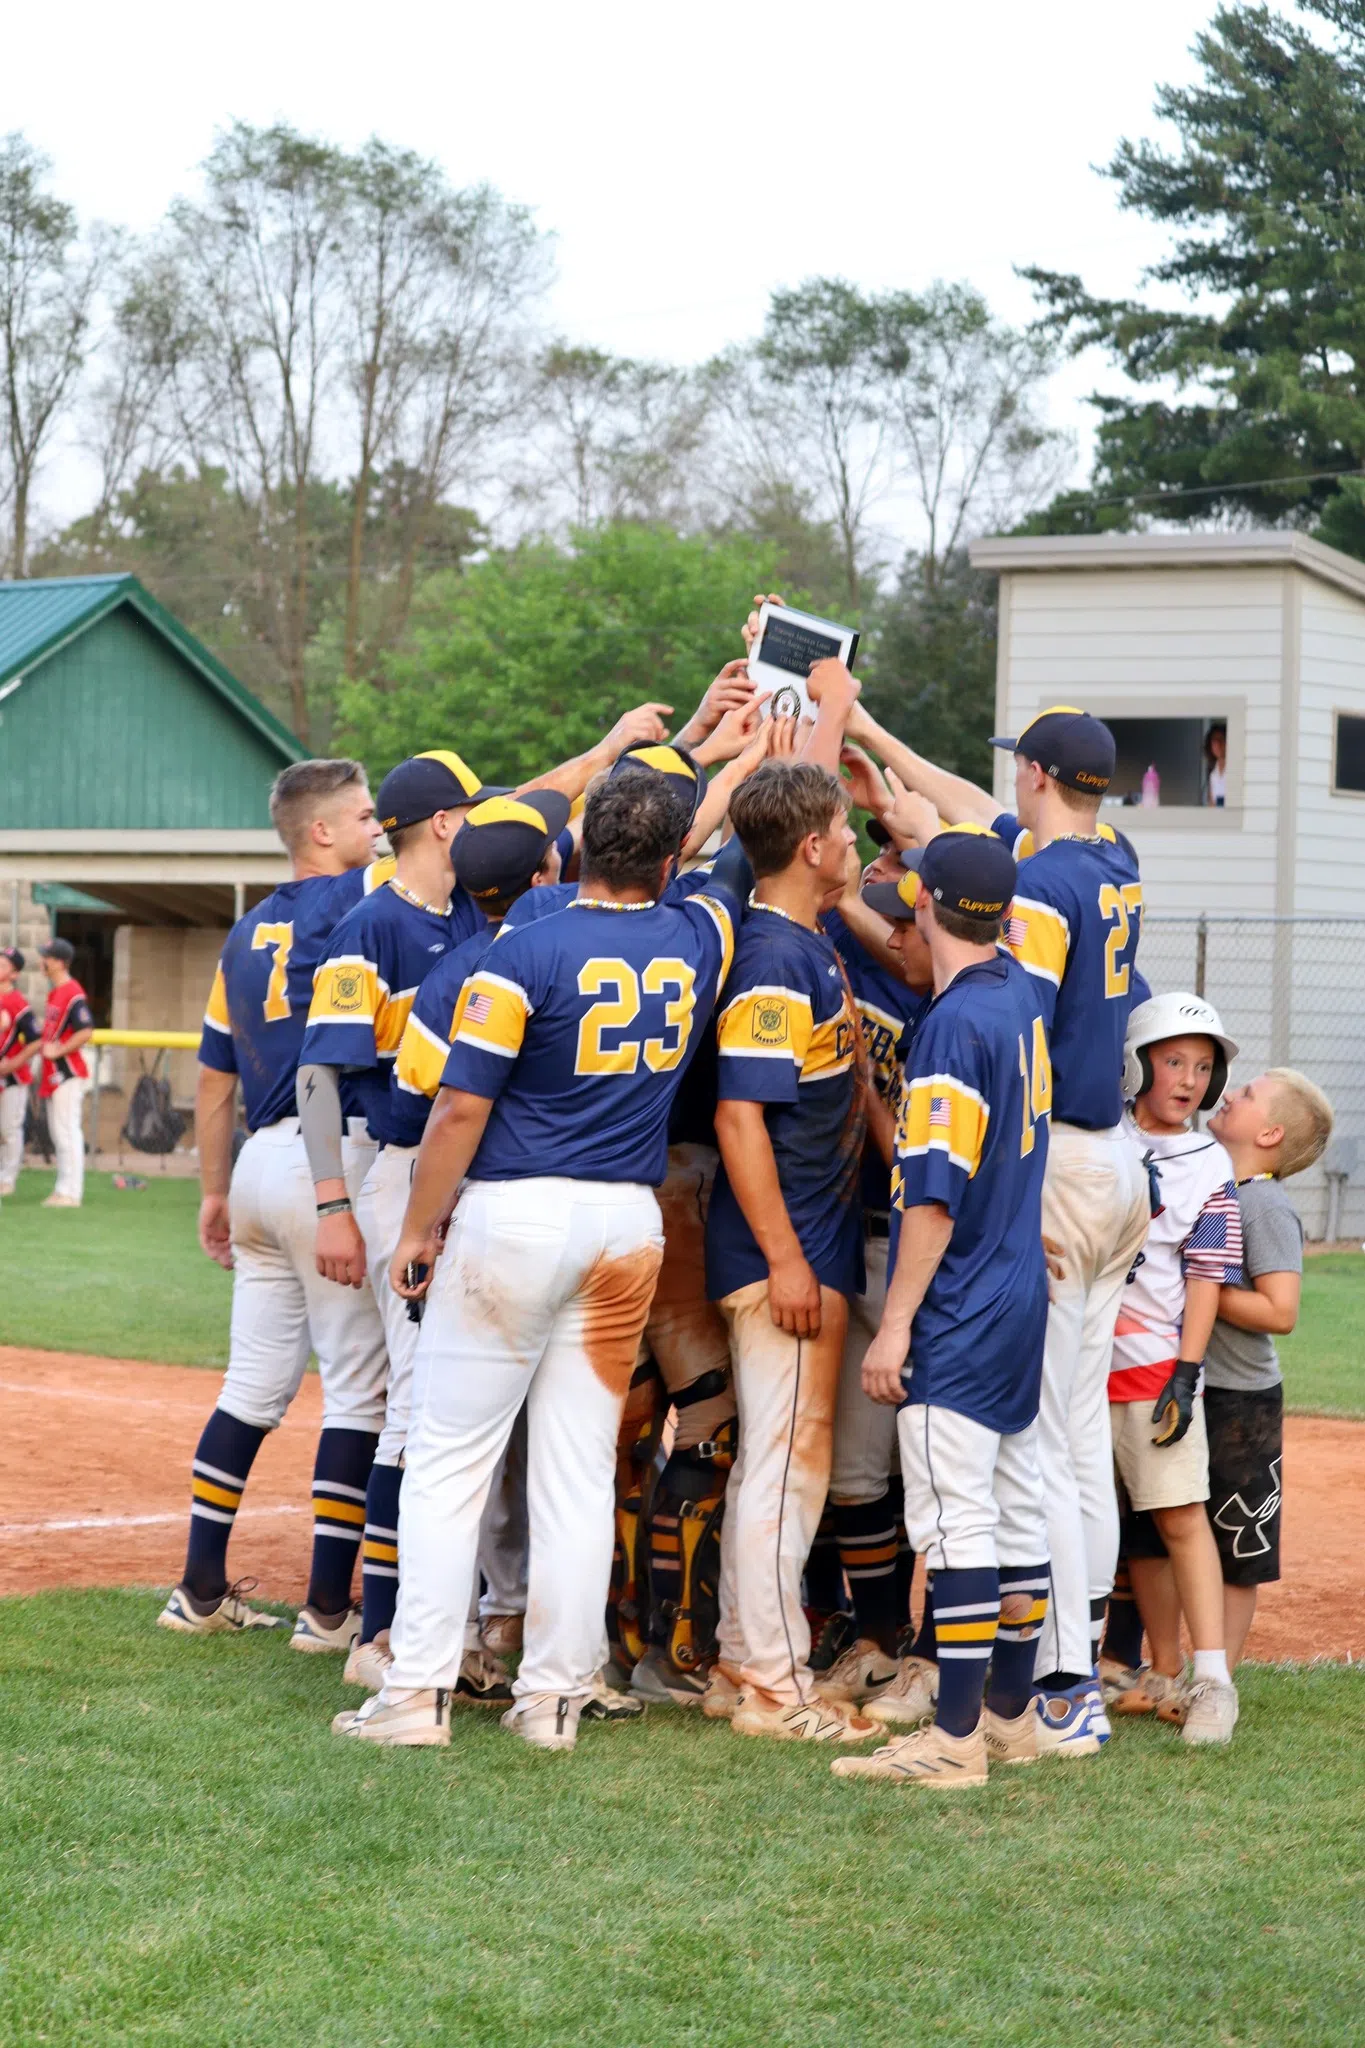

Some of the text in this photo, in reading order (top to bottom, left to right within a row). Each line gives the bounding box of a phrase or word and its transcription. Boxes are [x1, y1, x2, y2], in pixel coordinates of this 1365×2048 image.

[251, 920, 293, 1022] 7
[1098, 882, 1144, 999] 27
[574, 957, 697, 1076] 23
[1018, 1015, 1053, 1159] 14
